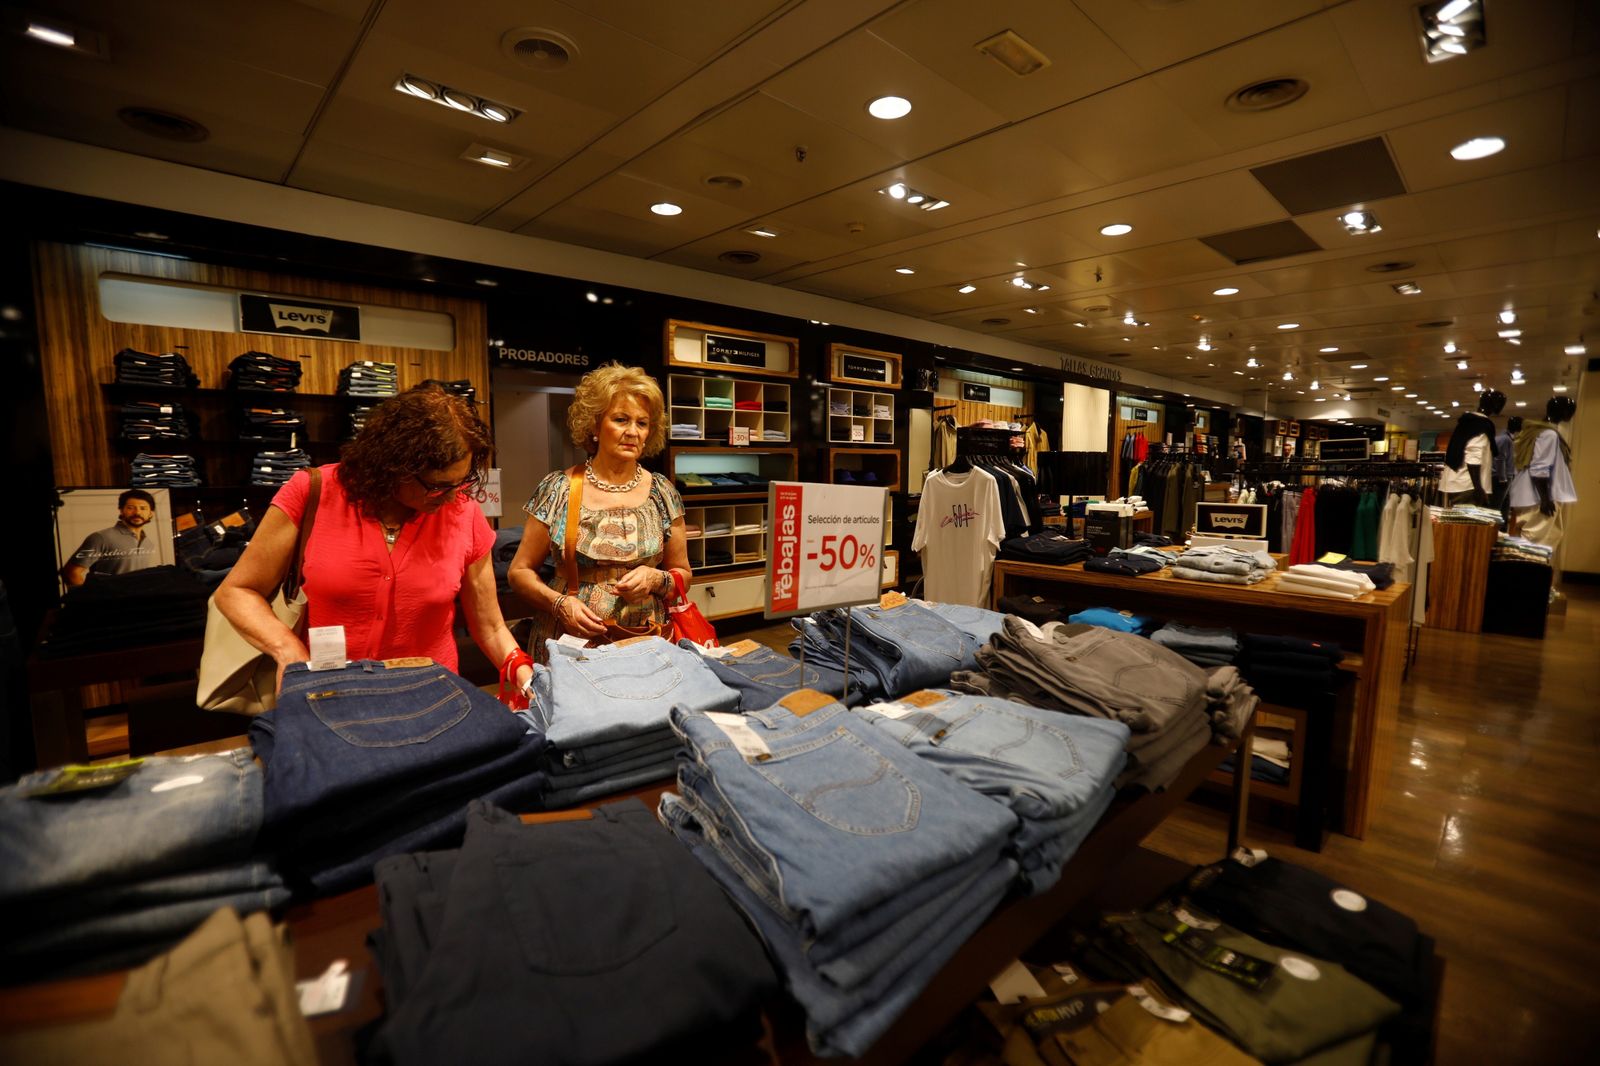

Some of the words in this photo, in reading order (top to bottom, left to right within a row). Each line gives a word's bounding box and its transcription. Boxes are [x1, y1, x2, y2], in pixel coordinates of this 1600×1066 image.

[499, 348, 589, 366] PROBADORES
[807, 514, 841, 525] Selección
[843, 515, 852, 524] de
[853, 515, 880, 525] artículos
[777, 504, 798, 599] rebajas
[807, 534, 876, 572] -50%
